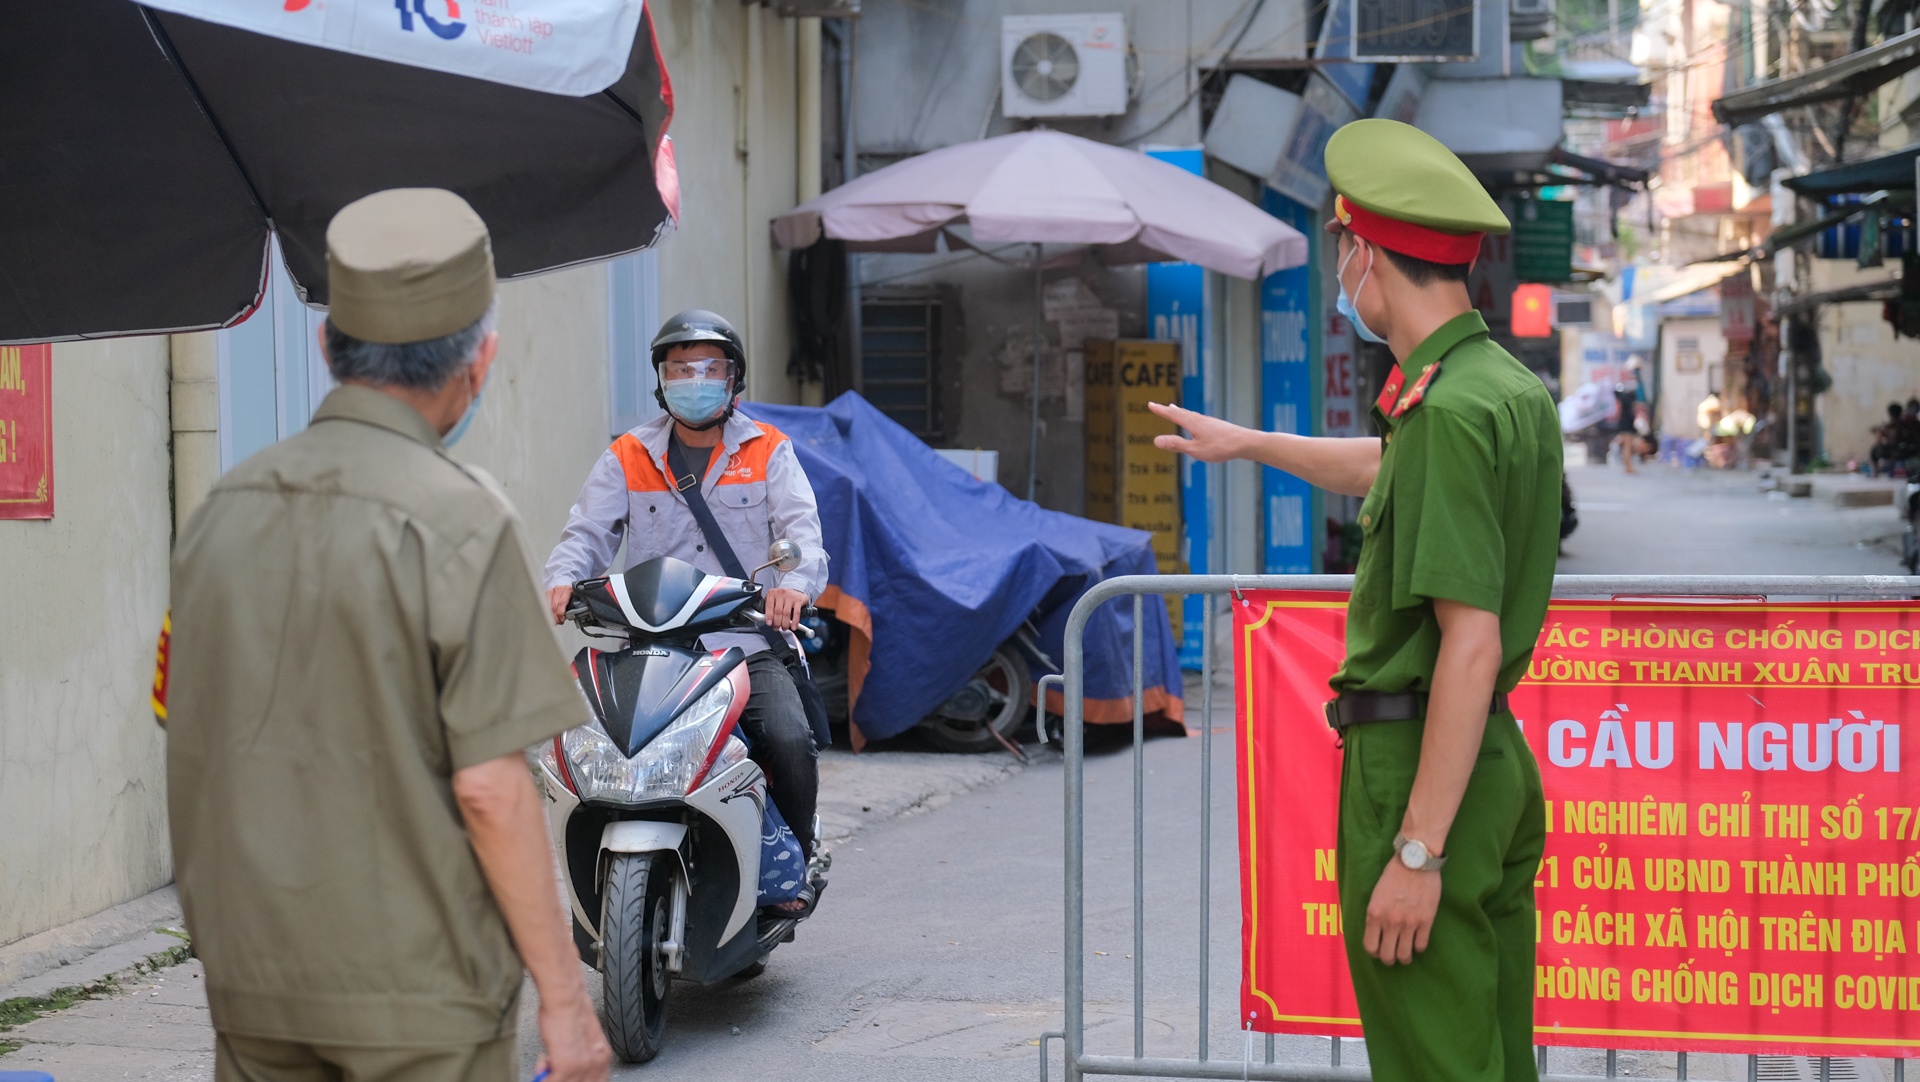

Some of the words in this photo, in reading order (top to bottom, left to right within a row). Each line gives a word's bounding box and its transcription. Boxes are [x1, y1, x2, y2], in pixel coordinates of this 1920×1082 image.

[477, 27, 534, 55] Vietlott
[1121, 362, 1178, 387] CAFE
[1600, 623, 1714, 649] PHÒNG
[1725, 620, 1843, 650] CHỐNG
[1522, 655, 1620, 681] ƯỜNG
[1630, 661, 1742, 682] THANH
[1753, 657, 1849, 684] XUÂN
[1547, 703, 1674, 769] CẦU
[1699, 710, 1901, 773] NGƯỜI
[718, 771, 744, 792] HONDA
[1564, 794, 1687, 836] NGHIÊM
[1698, 790, 1751, 837] CHỈ
[1761, 804, 1809, 847] THỊ
[1820, 793, 1864, 840] SỐ
[1573, 842, 1635, 891] CỦA
[1644, 858, 1731, 893] UBND
[1740, 854, 1847, 895] THÀNH
[1302, 902, 1344, 936] TH
[1552, 904, 1635, 946] CÁCH
[1645, 907, 1688, 948] XÃ
[1697, 908, 1749, 957] HỘI
[1759, 910, 1841, 952] TRÊN
[1851, 919, 1907, 961] ĐỊA
[1631, 958, 1738, 1005] CHỐNG
[1749, 972, 1824, 1014] DỊCH
